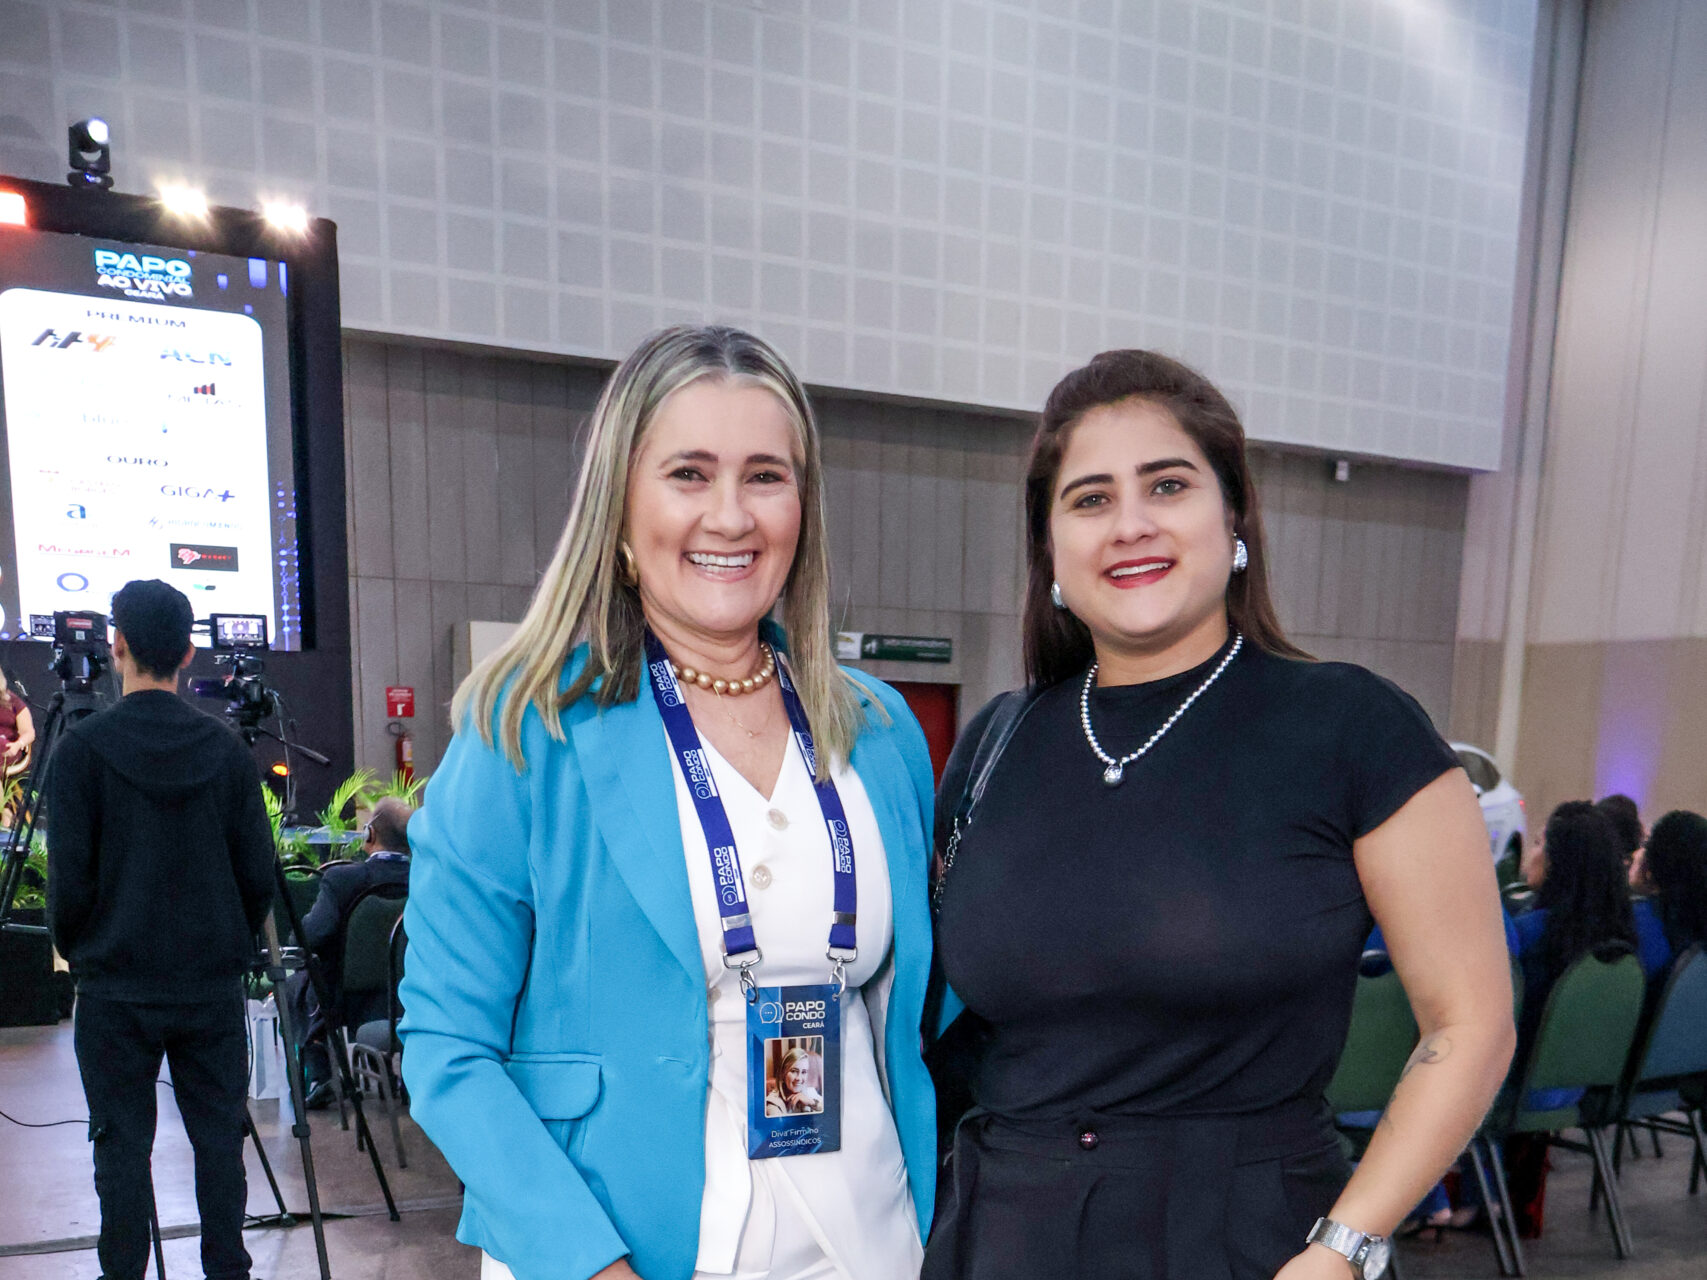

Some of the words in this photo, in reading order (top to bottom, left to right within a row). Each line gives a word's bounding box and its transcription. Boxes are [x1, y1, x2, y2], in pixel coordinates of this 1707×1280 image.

[95, 249, 192, 278] PAPO
[97, 273, 132, 289] AO
[132, 278, 193, 297] VIVO
[106, 455, 169, 467] OURO
[650, 663, 667, 691] PAPO
[657, 661, 673, 689] CONDO
[683, 750, 700, 783] PAPO
[690, 749, 706, 781] CONDO
[713, 847, 730, 886] PAPO
[720, 846, 734, 884] CONDO
[837, 837, 846, 873] CONDO
[842, 837, 852, 873] PAPO
[785, 1000, 826, 1012] PAPO
[785, 1010, 826, 1021] CONDO
[802, 1020, 825, 1029] CEARÁ
[771, 1129, 788, 1138] Diva
